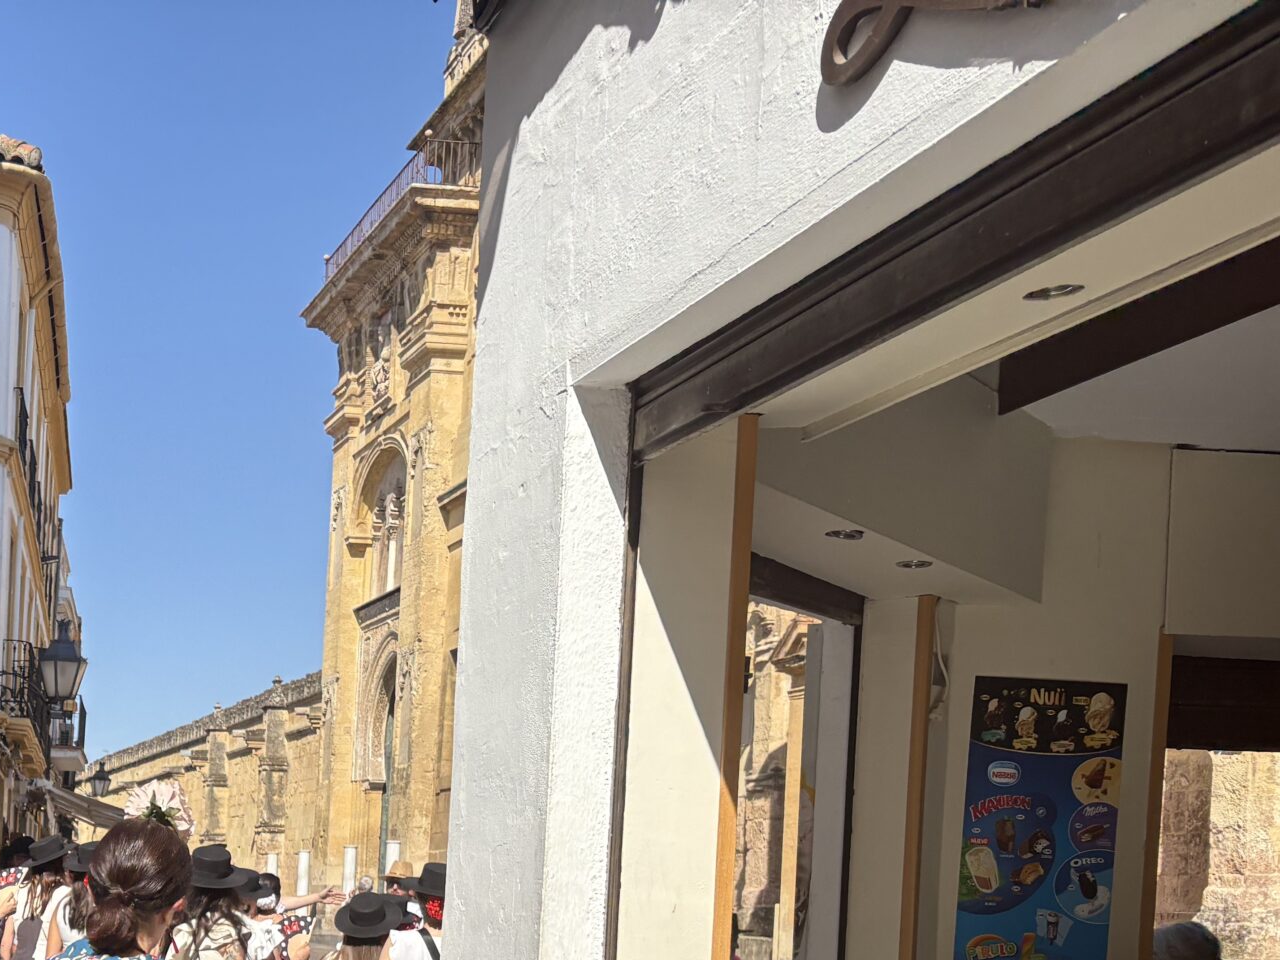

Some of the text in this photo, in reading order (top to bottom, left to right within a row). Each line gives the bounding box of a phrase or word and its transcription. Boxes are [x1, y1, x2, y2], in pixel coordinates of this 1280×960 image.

[969, 794, 1032, 822] MAXIBON
[1082, 805, 1109, 817] Milka
[1070, 857, 1105, 868] OREO
